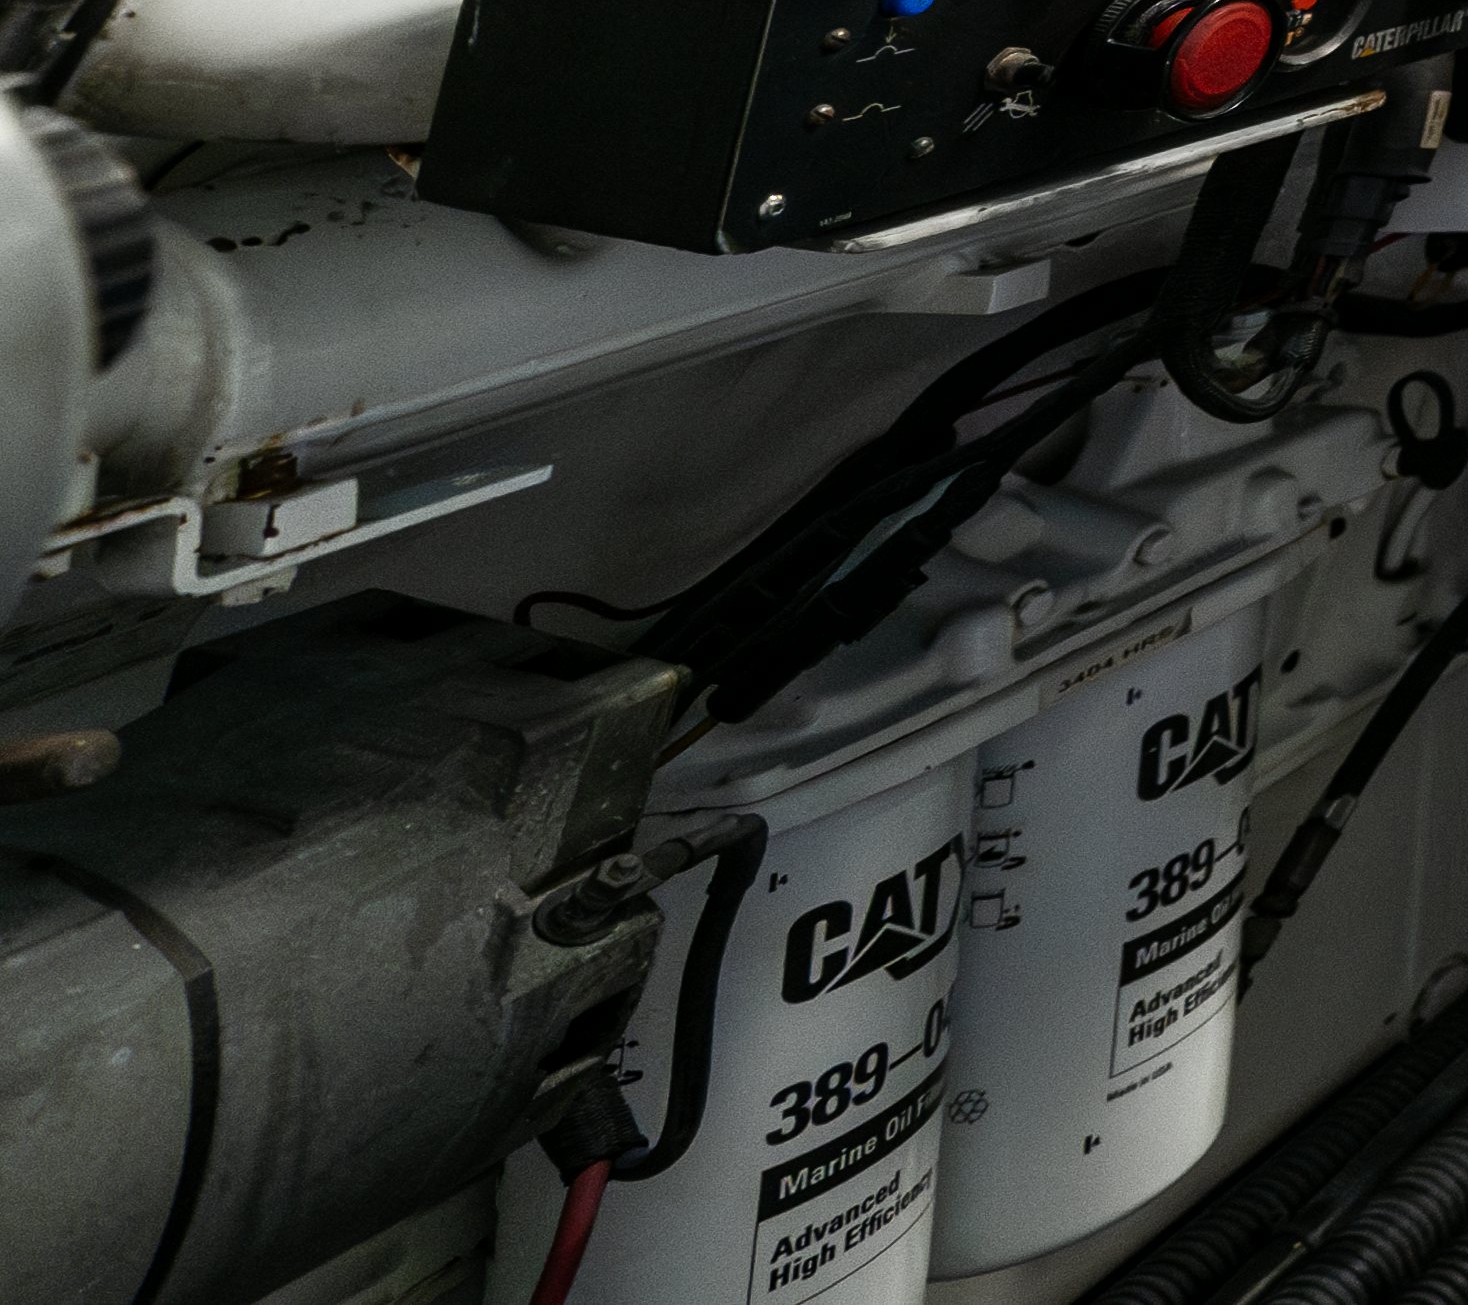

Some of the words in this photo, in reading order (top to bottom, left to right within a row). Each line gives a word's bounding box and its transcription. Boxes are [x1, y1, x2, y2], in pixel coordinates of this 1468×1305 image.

[1352, 9, 1466, 60] CATERPILLAR
[1137, 662, 1263, 802] CAT
[781, 841, 953, 1004] CAT
[1135, 914, 1208, 969] Marine
[1128, 947, 1224, 1024] Advanced
[1128, 1005, 1178, 1047] High
[765, 993, 950, 1147] 389-0
[778, 1132, 877, 1200] Marine
[885, 1102, 911, 1142] Oil
[770, 1170, 901, 1265] Advanced
[768, 1243, 836, 1292] High
